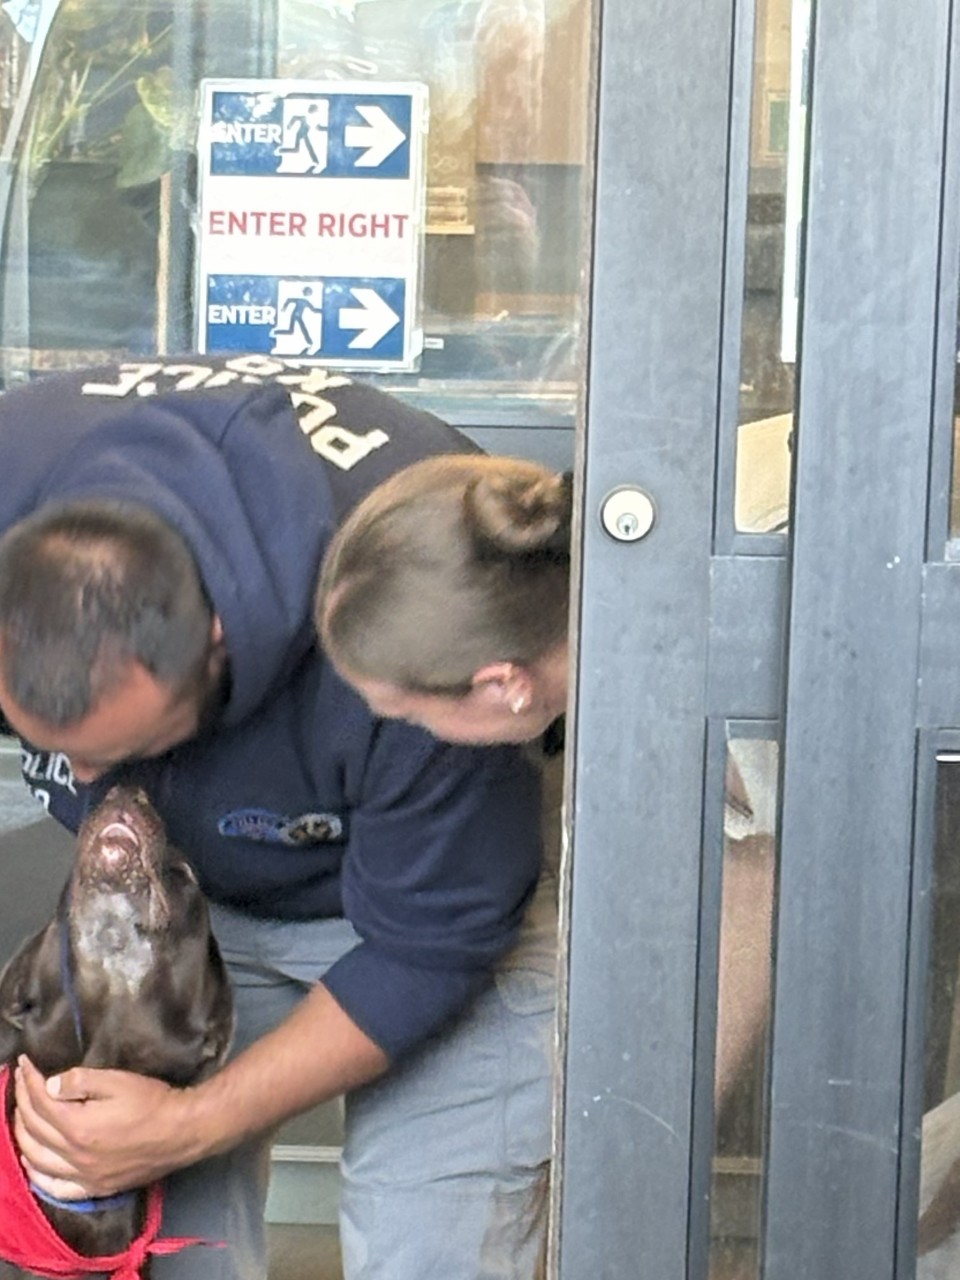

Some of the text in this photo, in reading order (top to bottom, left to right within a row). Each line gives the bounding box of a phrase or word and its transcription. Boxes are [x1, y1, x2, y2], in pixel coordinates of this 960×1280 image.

[211, 121, 282, 145] ENTER
[208, 211, 409, 238] ENTER RIGHT
[208, 304, 276, 325] ENTER
